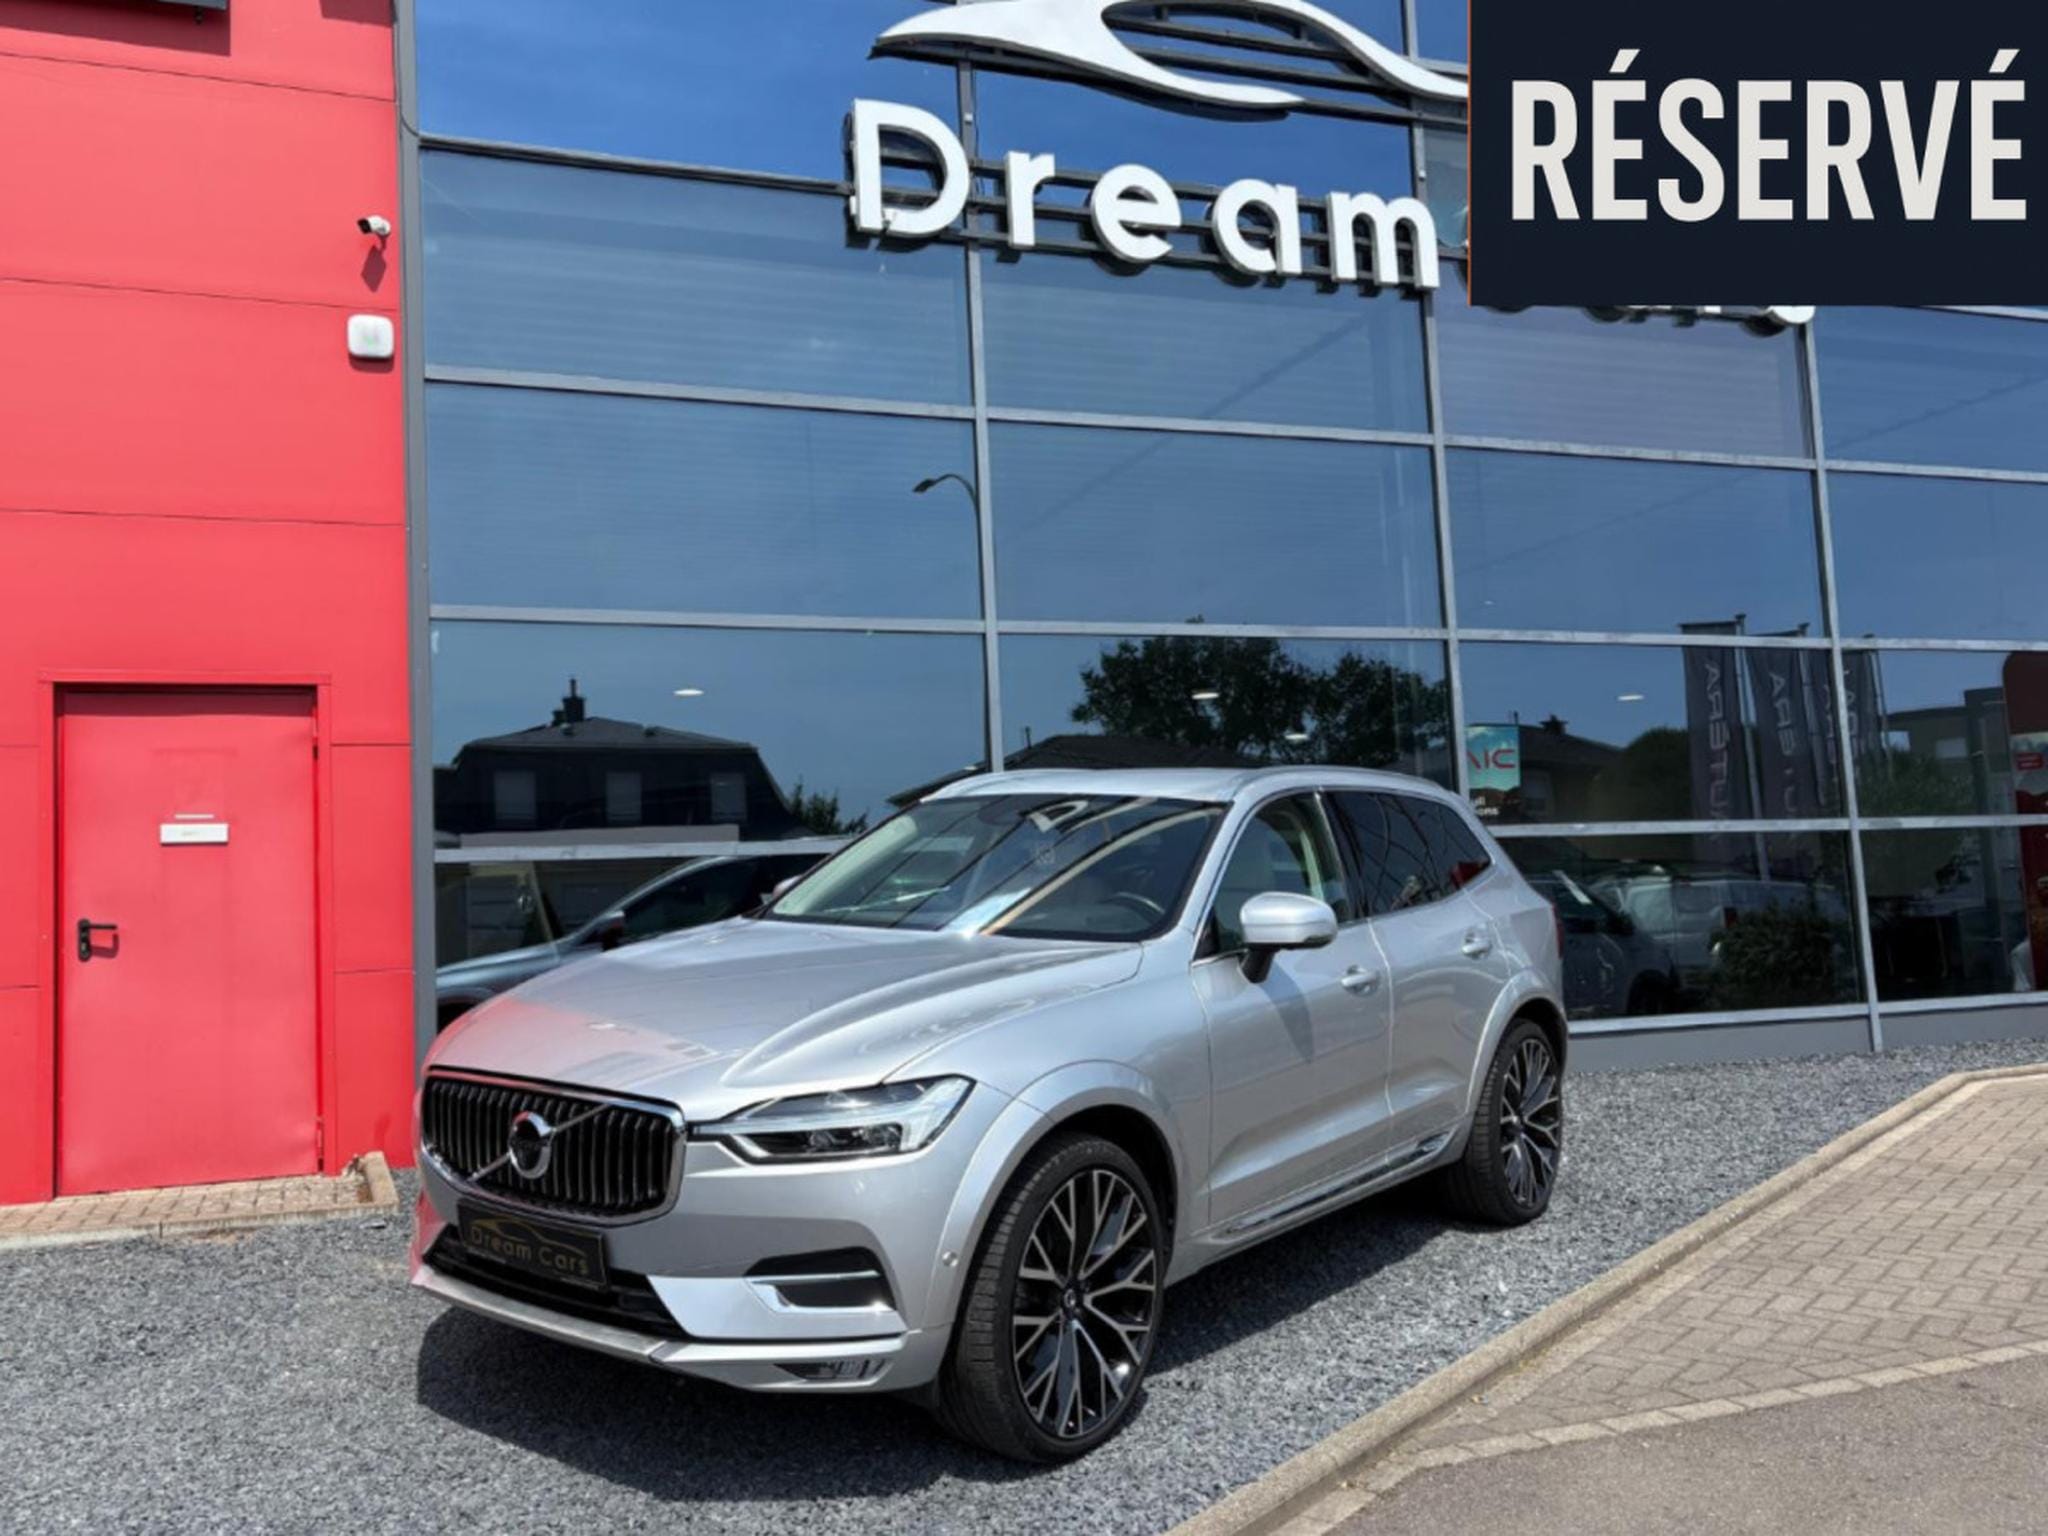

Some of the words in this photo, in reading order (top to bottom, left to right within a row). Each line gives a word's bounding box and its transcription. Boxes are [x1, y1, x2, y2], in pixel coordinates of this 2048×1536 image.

[851, 98, 1440, 289] Dream
[471, 1225, 532, 1261] Dream
[537, 1246, 590, 1276] Cars
